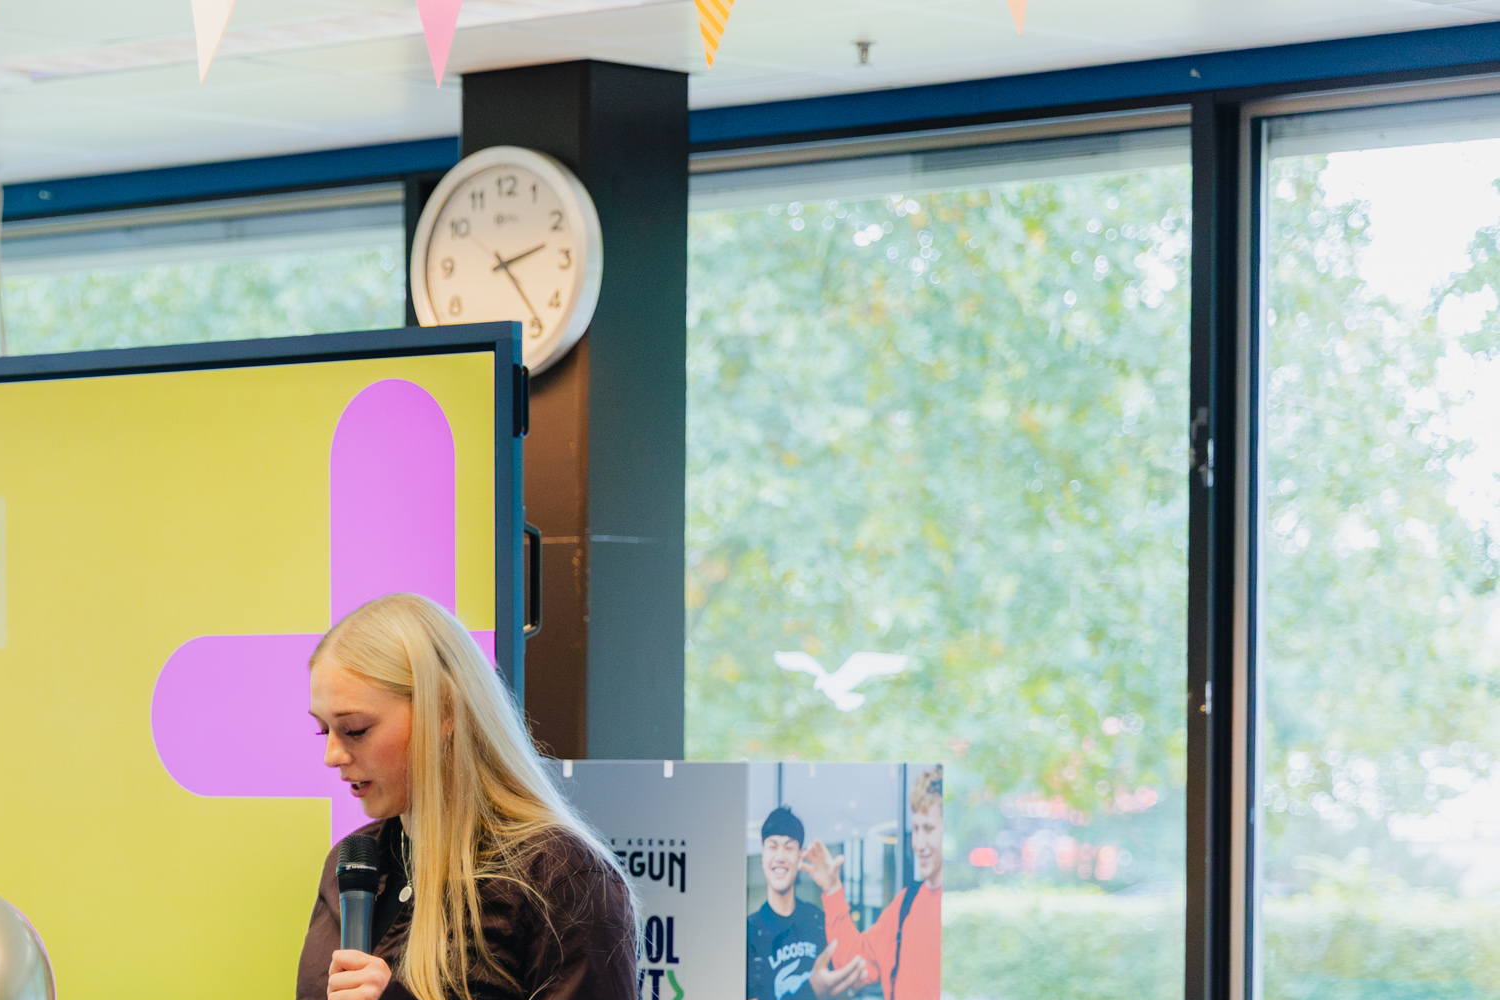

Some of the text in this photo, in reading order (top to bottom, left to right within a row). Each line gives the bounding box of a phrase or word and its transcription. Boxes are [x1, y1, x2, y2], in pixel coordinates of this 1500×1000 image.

[496, 175, 519, 197] 12
[529, 184, 537, 204] 1
[470, 191, 485, 210] 11
[451, 218, 471, 239] 10
[549, 210, 564, 232] 2
[441, 258, 455, 278] 9
[559, 248, 572, 270] 3
[548, 290, 561, 309] 4
[627, 838, 686, 846] AGENDA
[637, 915, 679, 964] OL
[768, 941, 817, 970] LACOSTE
